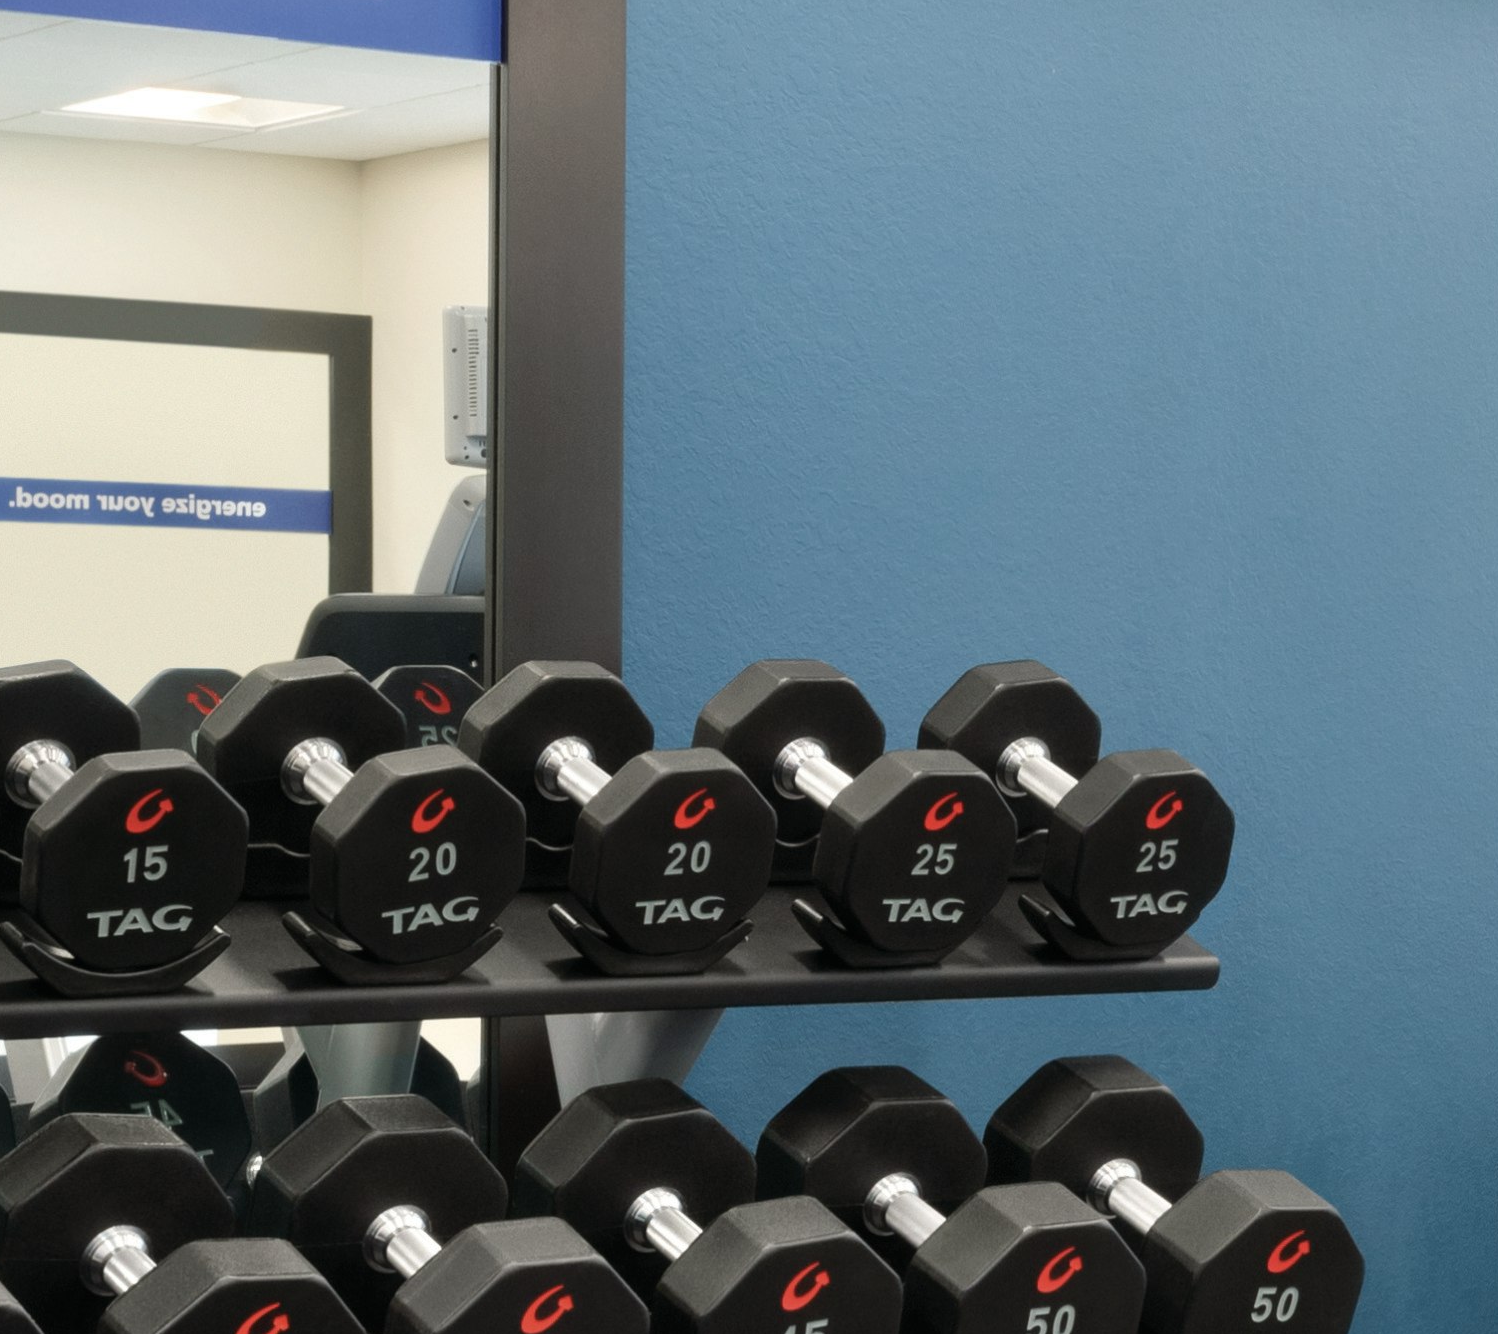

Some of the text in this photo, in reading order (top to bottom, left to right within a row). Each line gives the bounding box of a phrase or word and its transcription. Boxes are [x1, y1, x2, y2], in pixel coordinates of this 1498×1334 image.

[123, 844, 169, 884] 15
[408, 841, 457, 883] 20
[663, 840, 712, 876] 20
[910, 843, 958, 876] 25
[1135, 838, 1179, 873] 25
[86, 904, 193, 938] TAG
[381, 895, 480, 935] TAG
[635, 895, 726, 925] TAG
[882, 897, 965, 924] TAG
[1109, 890, 1189, 919] TAG
[1250, 1286, 1299, 1323] 50
